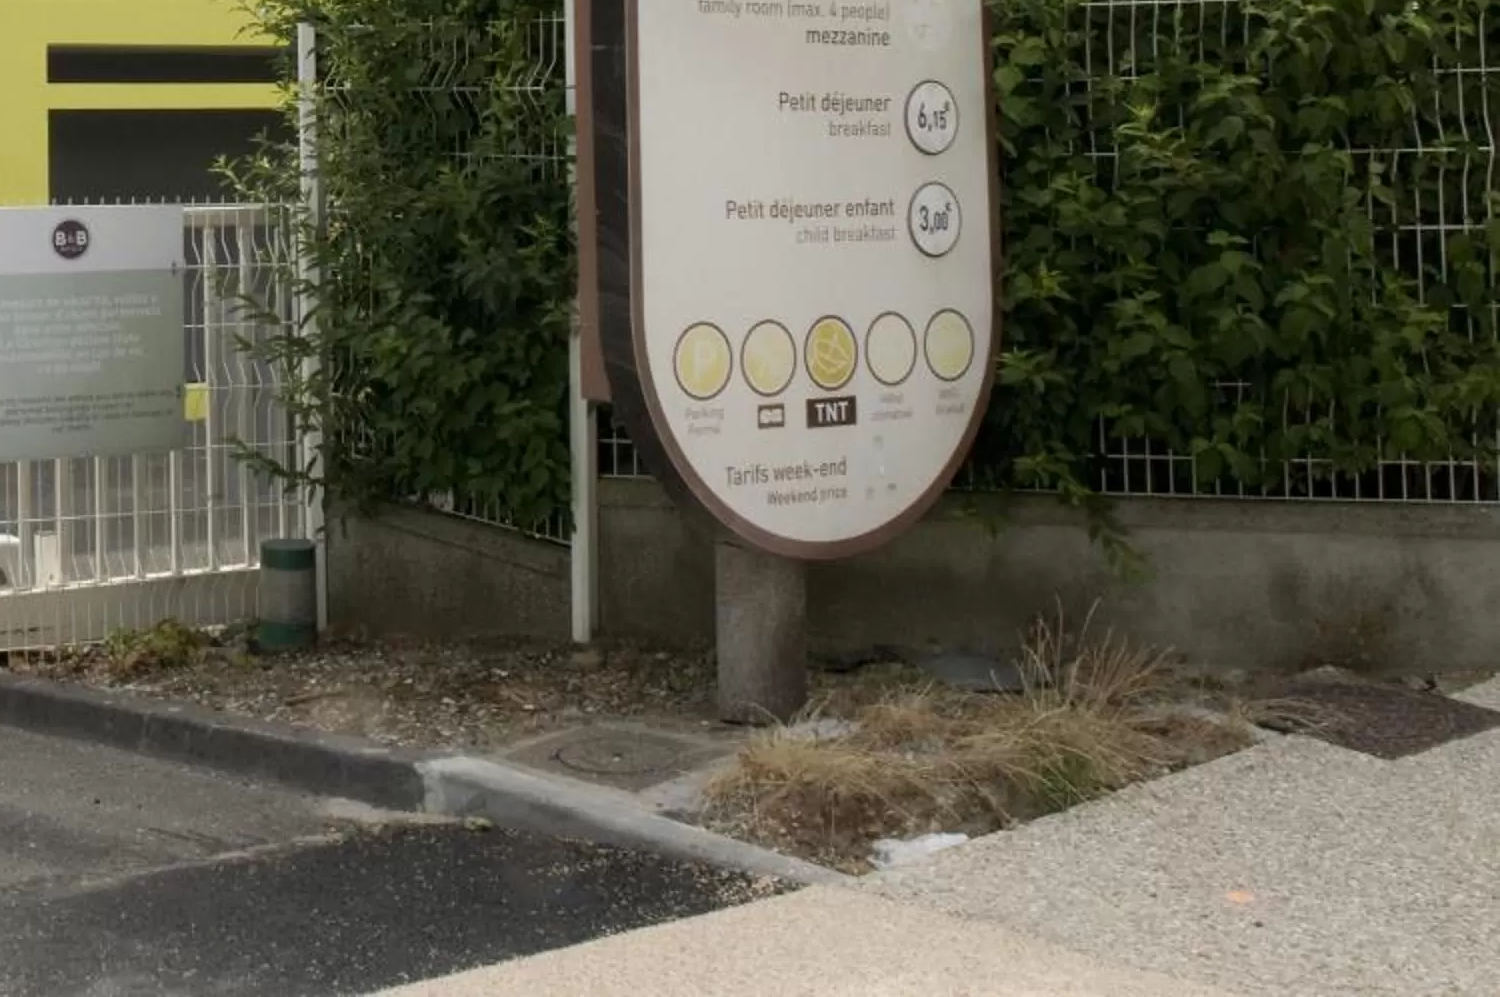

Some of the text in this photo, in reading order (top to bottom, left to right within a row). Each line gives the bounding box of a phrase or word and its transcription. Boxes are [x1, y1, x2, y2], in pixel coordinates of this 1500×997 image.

[829, 2, 838, 18] 4
[805, 28, 891, 47] mezzanine
[778, 91, 892, 117] Petit déjeuner
[827, 120, 892, 138] breakfast
[725, 200, 765, 221] Petit
[844, 199, 895, 219] enfant
[796, 225, 897, 245] child breakfast
[814, 401, 850, 424] TNT
[724, 456, 848, 489] Tarifs week-end
